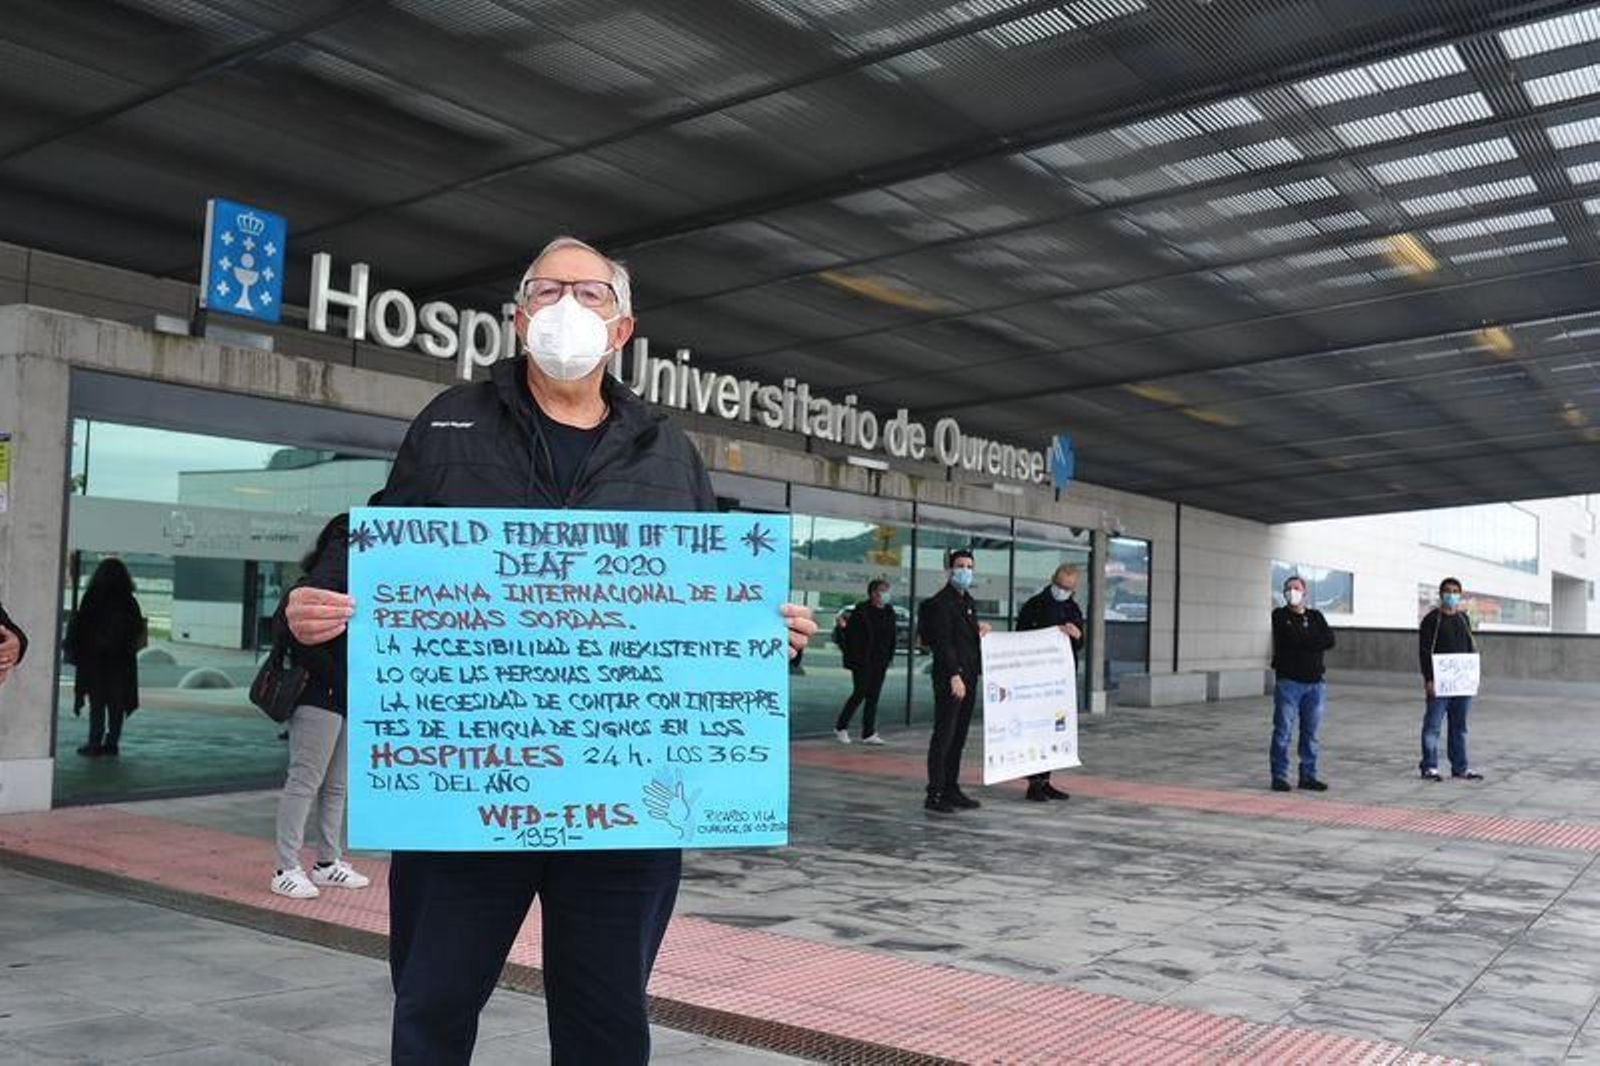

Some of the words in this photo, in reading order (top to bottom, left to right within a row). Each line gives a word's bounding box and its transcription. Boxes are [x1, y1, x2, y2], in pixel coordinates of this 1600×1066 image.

[608, 337, 879, 451] Universitario
[882, 409, 927, 460] de
[934, 417, 1046, 484] Ourense
[373, 518, 488, 548] WORLD
[502, 520, 628, 549] FEDERATION
[639, 523, 668, 548] OF
[673, 523, 728, 553] THE
[493, 549, 588, 581] DEAF
[594, 553, 667, 577] 2020
[372, 583, 492, 606] SEMANA
[502, 582, 686, 605] INTERNACIONAL
[687, 582, 718, 602] DE
[726, 581, 764, 602] LAS
[372, 608, 507, 631] PERSONAS
[517, 608, 637, 631] SORDAS.
[375, 633, 401, 656] LA
[411, 636, 571, 658] ACCESIBILIDAD
[577, 639, 602, 658] ES
[609, 639, 742, 659] INEXISTENTE
[748, 637, 785, 658] POR
[376, 665, 405, 684] LO
[409, 665, 454, 687] QUE
[458, 664, 490, 685] LAS
[495, 664, 591, 685] PERSONAS
[597, 664, 665, 684] SORDAS
[380, 692, 410, 713] LA
[416, 688, 528, 713] NECESIDAD
[532, 692, 563, 712] DE
[568, 691, 641, 714] CONTAR
[646, 691, 681, 711] CON
[363, 717, 411, 737] TES
[417, 718, 450, 740] DE
[458, 716, 547, 741] LENGUA
[547, 717, 578, 738] DE
[582, 718, 652, 738] SIGNOS
[658, 718, 689, 736] EN
[700, 719, 746, 737] LOS
[370, 741, 565, 770] HOSPITALES
[666, 745, 702, 764] LOS
[707, 745, 771, 764] 365
[366, 771, 421, 792] DIAS
[428, 770, 480, 792] DEL
[484, 768, 531, 794] AÑO
